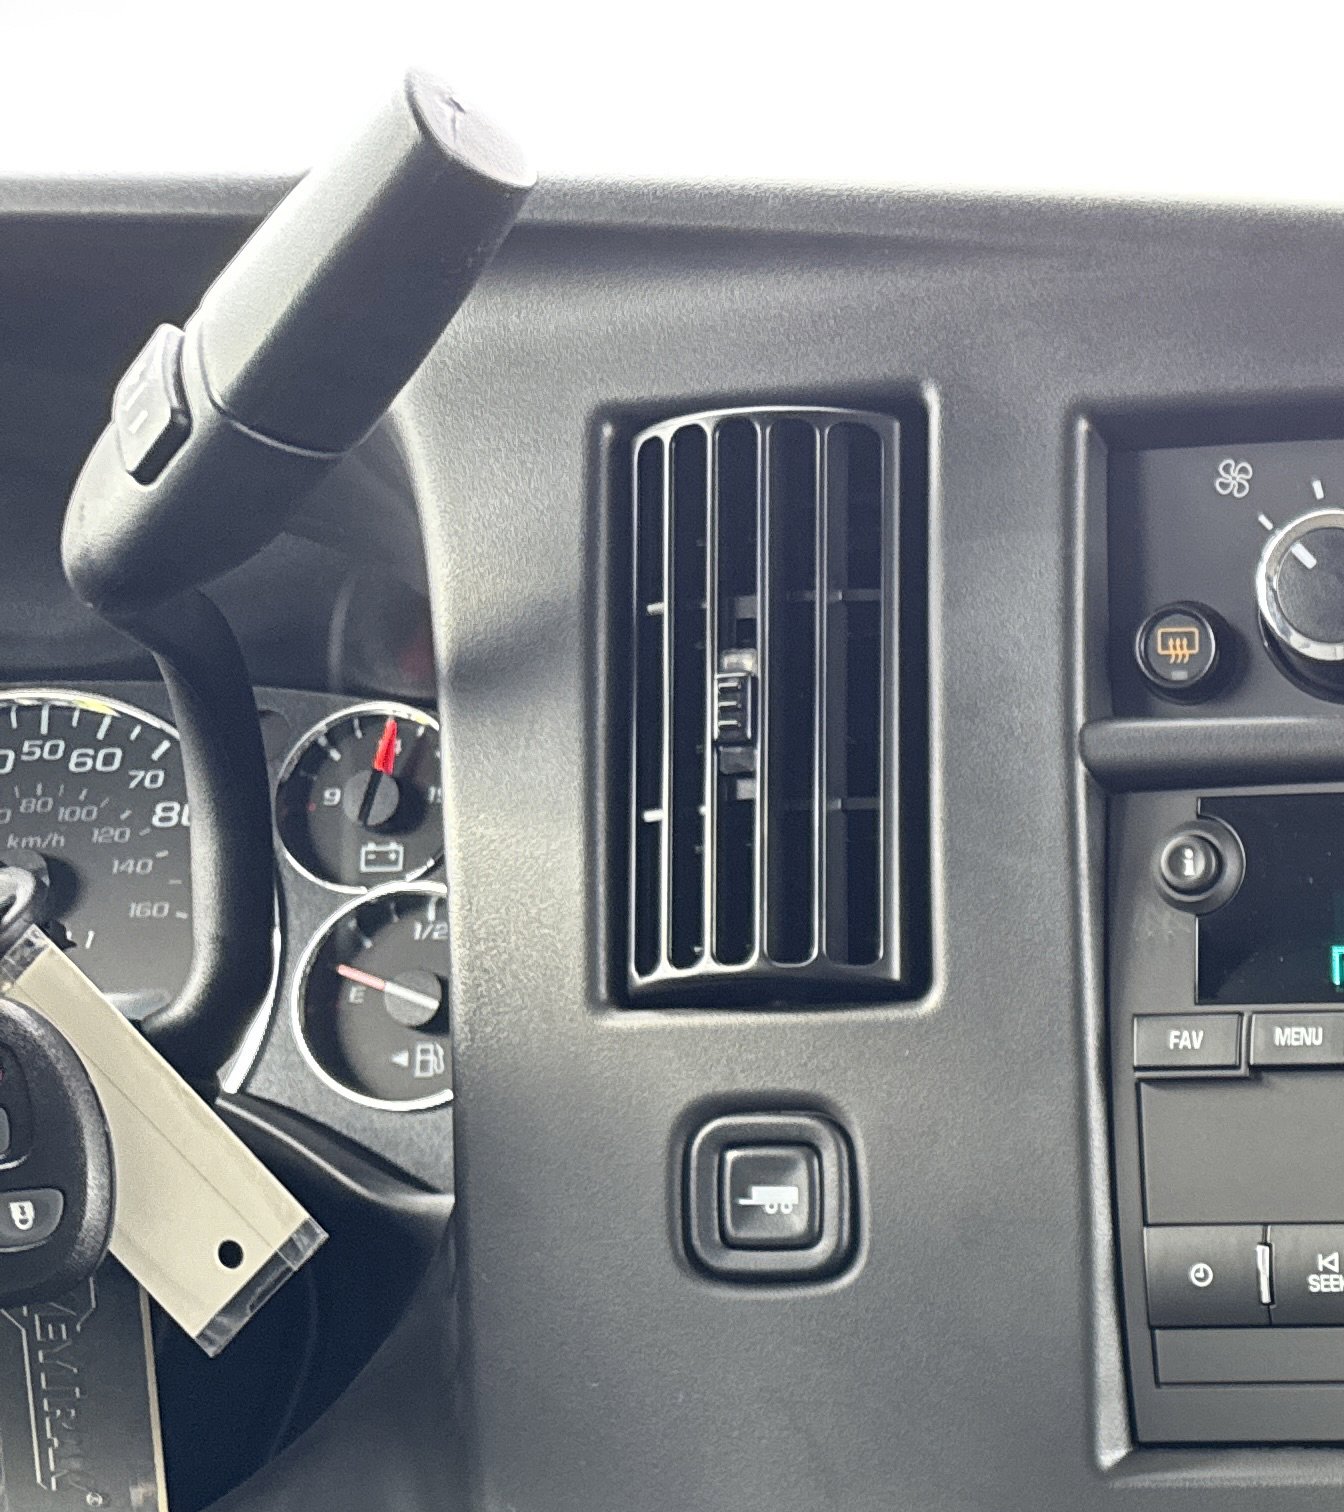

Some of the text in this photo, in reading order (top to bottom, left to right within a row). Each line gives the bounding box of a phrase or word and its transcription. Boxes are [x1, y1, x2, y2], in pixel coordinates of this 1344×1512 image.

[20, 739, 65, 761] 50
[68, 747, 123, 773] 60
[128, 769, 165, 789] 70
[19, 797, 53, 814] 80
[323, 787, 342, 806] 9
[58, 805, 98, 822] 100
[7, 832, 65, 850] km/h
[92, 827, 131, 843] 120
[112, 858, 153, 875] 140
[129, 902, 169, 919] 160
[1169, 1030, 1204, 1050] FAV
[1274, 1027, 1323, 1046] MENU
